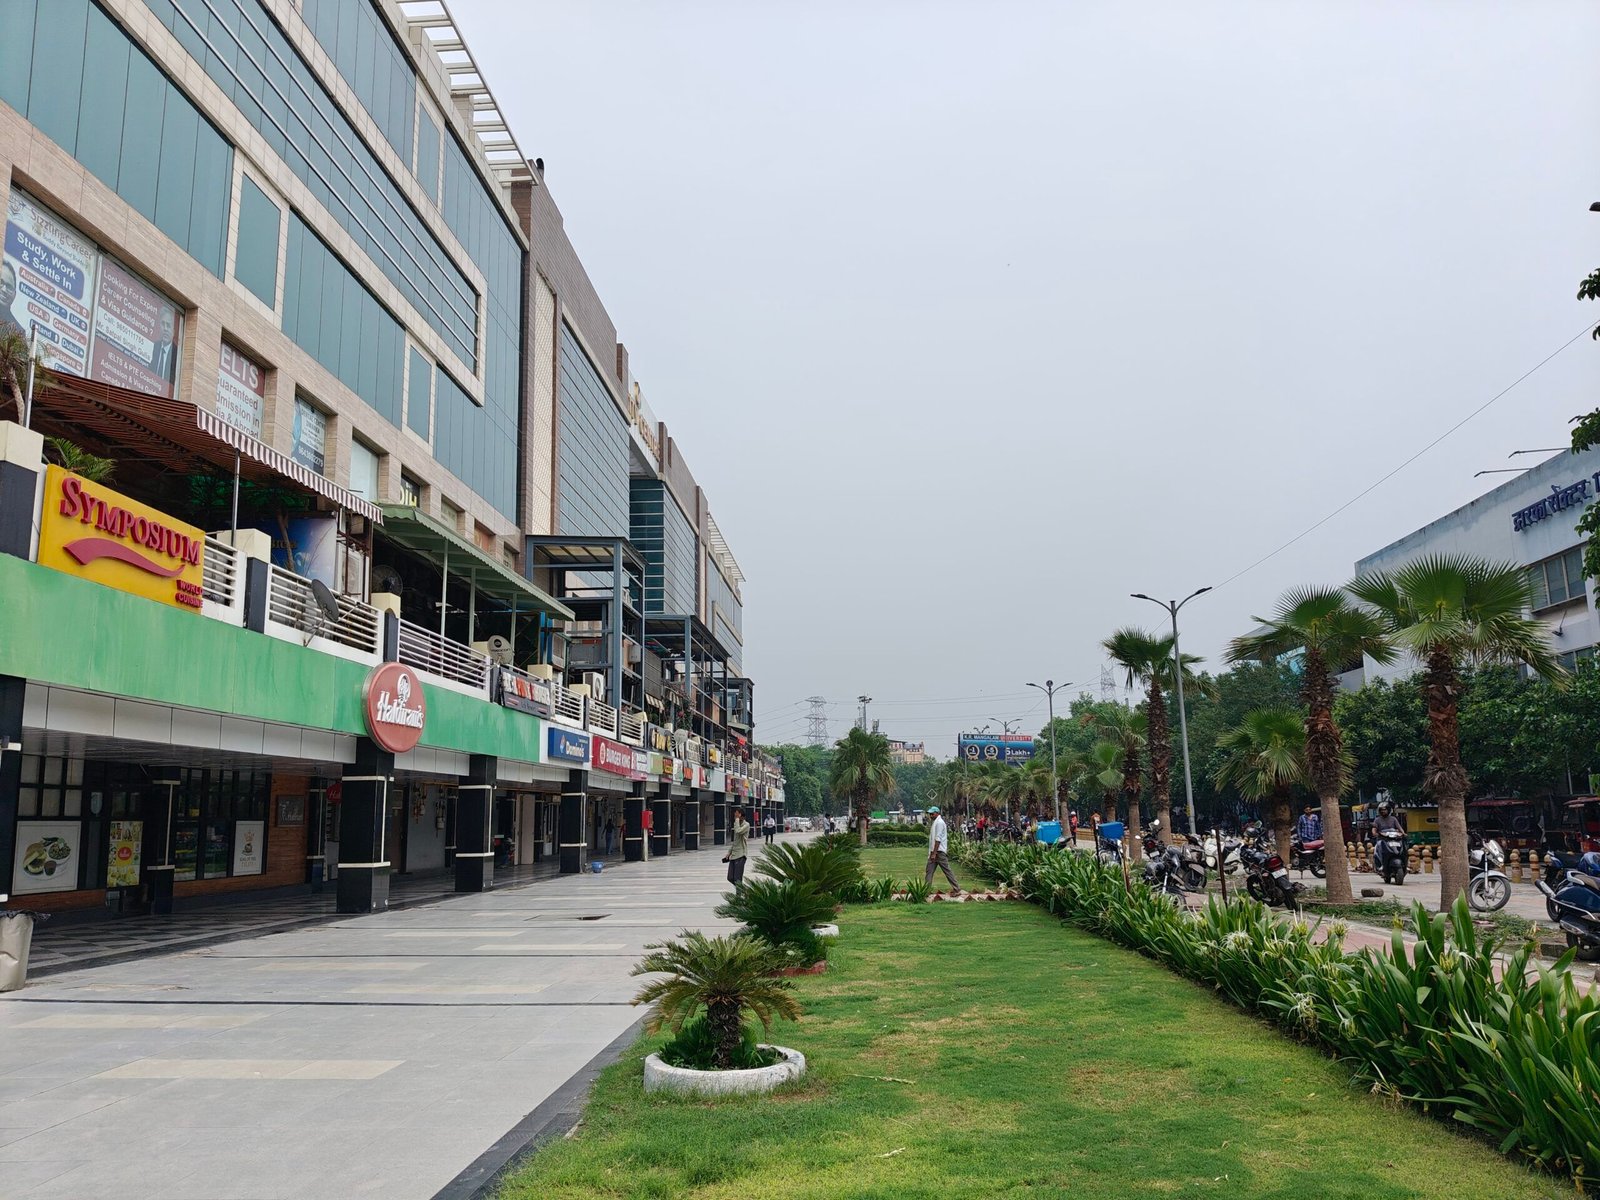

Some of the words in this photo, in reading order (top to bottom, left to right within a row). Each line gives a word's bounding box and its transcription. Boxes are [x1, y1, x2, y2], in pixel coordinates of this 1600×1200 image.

[17, 232, 48, 262] Study,
[51, 255, 76, 279] Work
[21, 269, 50, 293] Australia
[22, 250, 30, 263] &
[32, 257, 61, 283] Settle
[62, 277, 72, 291] In
[20, 284, 35, 298] New
[35, 293, 60, 314] Zealand
[102, 282, 123, 302] Career
[104, 269, 128, 294] Looking
[128, 288, 139, 300] For
[139, 295, 158, 316] Expert
[29, 304, 44, 319] USA
[58, 293, 81, 313] Canada
[70, 314, 81, 327] UK
[100, 295, 107, 304] &
[107, 298, 121, 314] Visa
[121, 309, 149, 333] Guidance
[54, 320, 80, 342] Germany
[62, 338, 79, 355] Dubai
[101, 359, 128, 380] Admission
[128, 376, 133, 384] &
[133, 378, 145, 390] Visa
[101, 371, 120, 386] Canada
[108, 352, 123, 366] IELTS
[128, 364, 139, 376] PTE
[139, 371, 162, 391] Coaching
[226, 414, 232, 424] &
[234, 418, 259, 439] Abroad
[252, 413, 260, 429] in
[60, 477, 201, 567] SYMPOSIUM
[176, 579, 204, 597] WORLD
[175, 592, 203, 608] CUISINE
[565, 740, 585, 758] Domino's
[606, 747, 622, 766] BURGER
